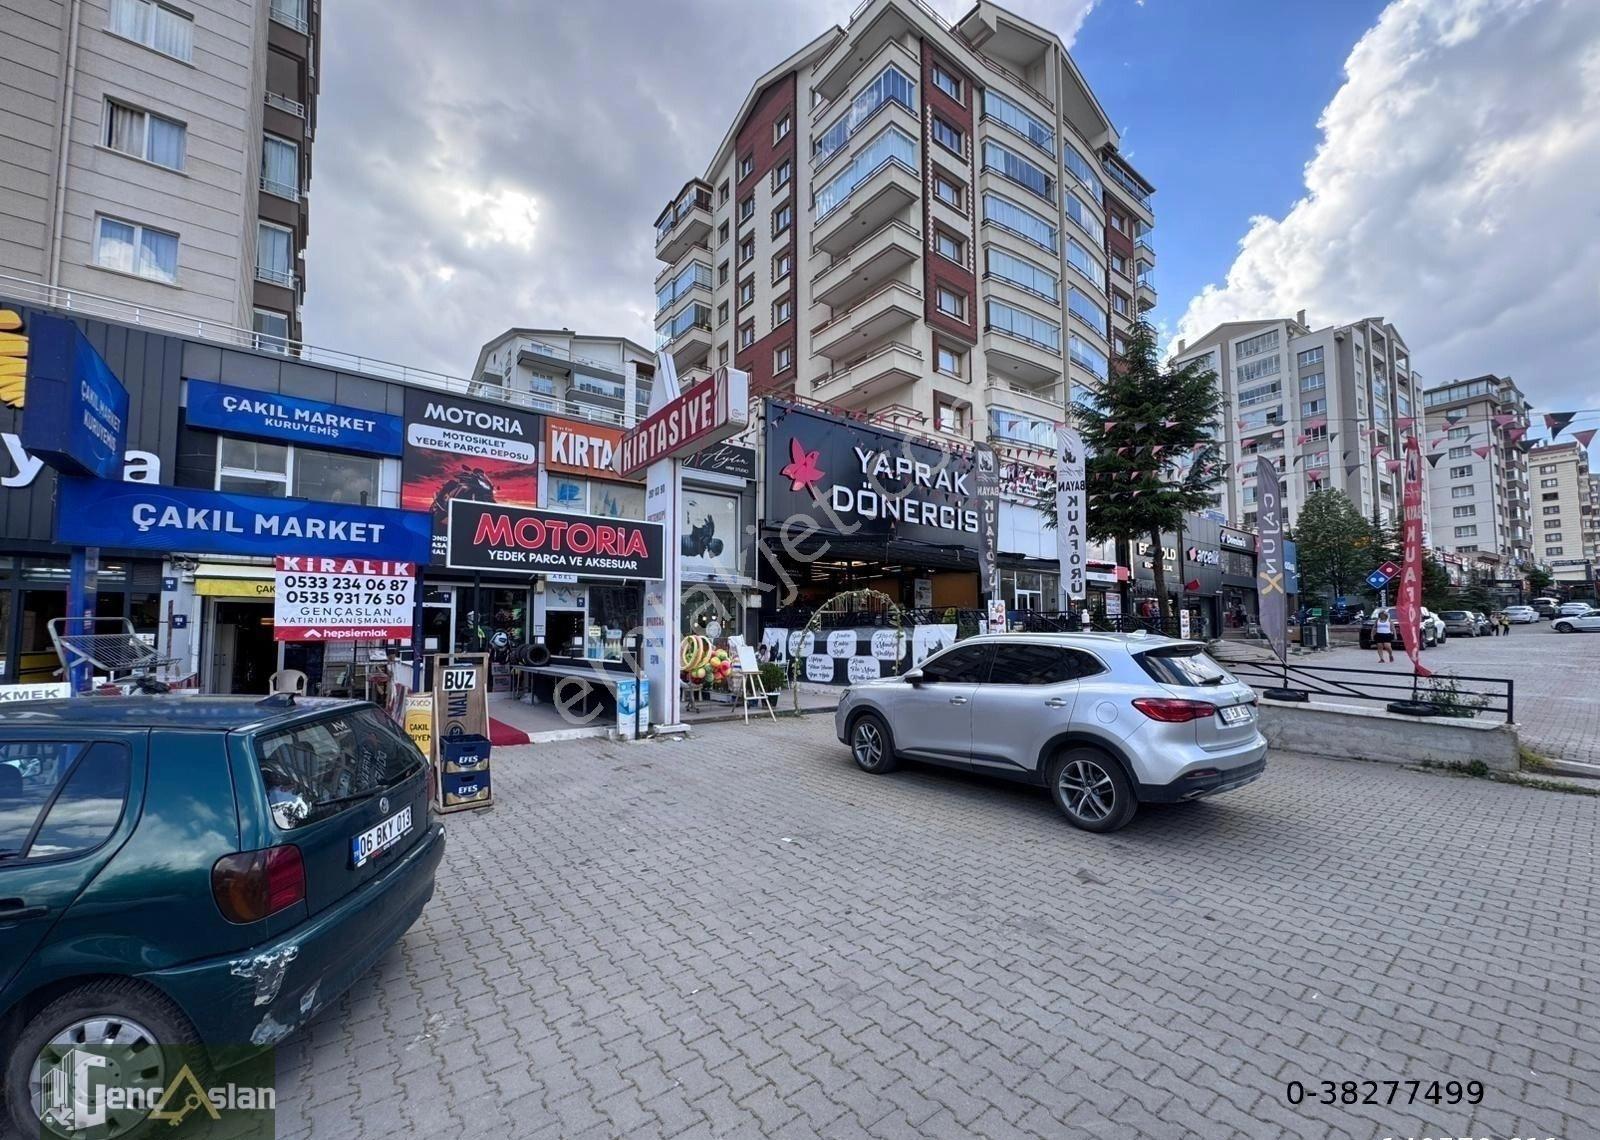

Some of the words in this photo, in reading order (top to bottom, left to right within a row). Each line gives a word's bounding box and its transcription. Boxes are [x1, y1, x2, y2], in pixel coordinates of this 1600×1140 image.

[81, 380, 99, 411] ÇAKIL
[100, 400, 120, 433] MARKET
[223, 396, 288, 418] ÇAKIL
[295, 409, 376, 432] MARKET
[265, 418, 339, 438] KURUYEMİŞ
[623, 387, 713, 472] KIRTASİYE
[416, 436, 451, 448] YEDEK
[453, 443, 488, 455] PARÇA
[490, 448, 528, 461] DEPOSU
[443, 431, 506, 448] MOTOSİKLET
[855, 446, 970, 496] YAPRAK
[132, 503, 244, 532] ÇAKIL
[254, 514, 385, 543] MARKET
[488, 549, 526, 562] YEDEK
[529, 553, 566, 565] PARCA
[569, 556, 583, 567] VE
[585, 558, 638, 570] AKSESUAR
[284, 576, 328, 589] 0533
[332, 577, 361, 590] 234
[365, 579, 386, 591] 06
[390, 580, 408, 591] 87
[286, 591, 329, 604] 0535
[334, 592, 359, 604] 931
[364, 593, 382, 605] 76
[386, 594, 405, 605] 50
[300, 606, 392, 617] GENÇASLAN
[330, 616, 406, 625] DANIŞMANLIĞI
[324, 629, 388, 639] hepsiemlak
[444, 671, 475, 689] BUZ
[410, 723, 429, 732] ÇAKIL
[459, 755, 478, 764] EFES
[458, 784, 478, 794] EFES
[360, 833, 373, 857] 06
[377, 820, 394, 846] BKY
[397, 809, 410, 832] 013
